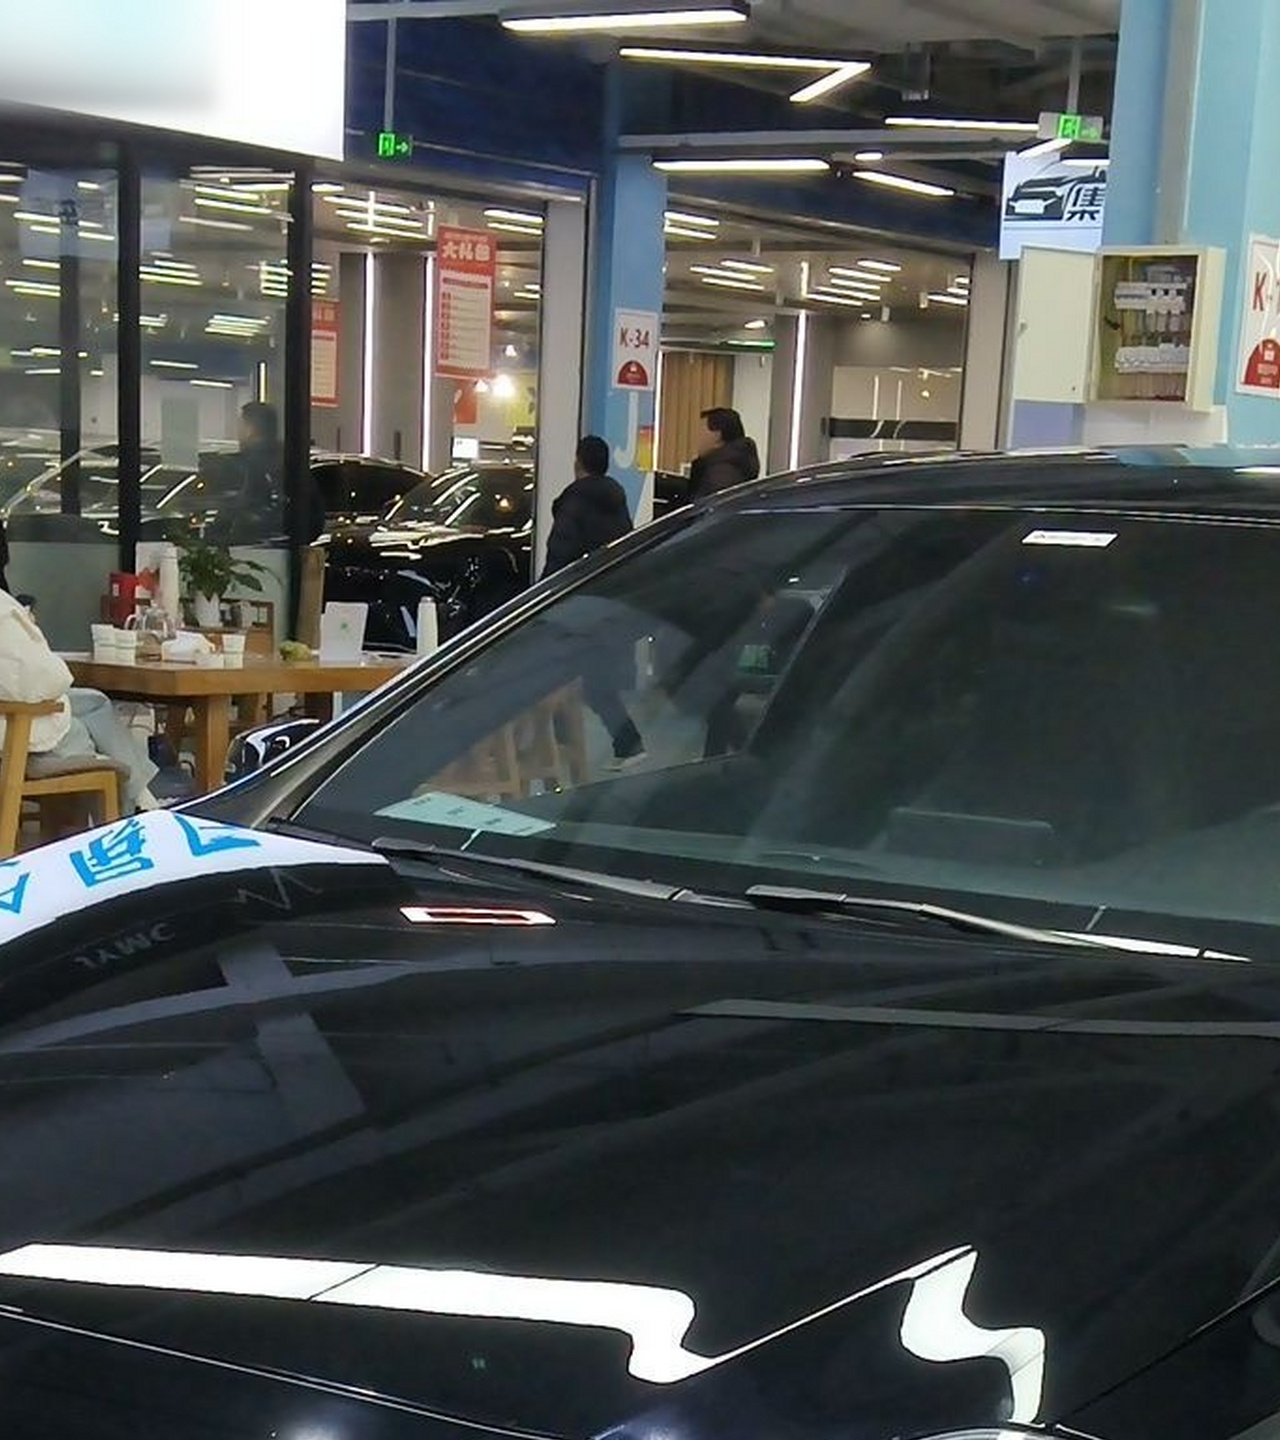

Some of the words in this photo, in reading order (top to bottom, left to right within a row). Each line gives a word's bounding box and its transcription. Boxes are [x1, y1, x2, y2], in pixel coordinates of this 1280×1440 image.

[441, 241, 491, 262] 大礼包
[619, 327, 650, 348] K-34
